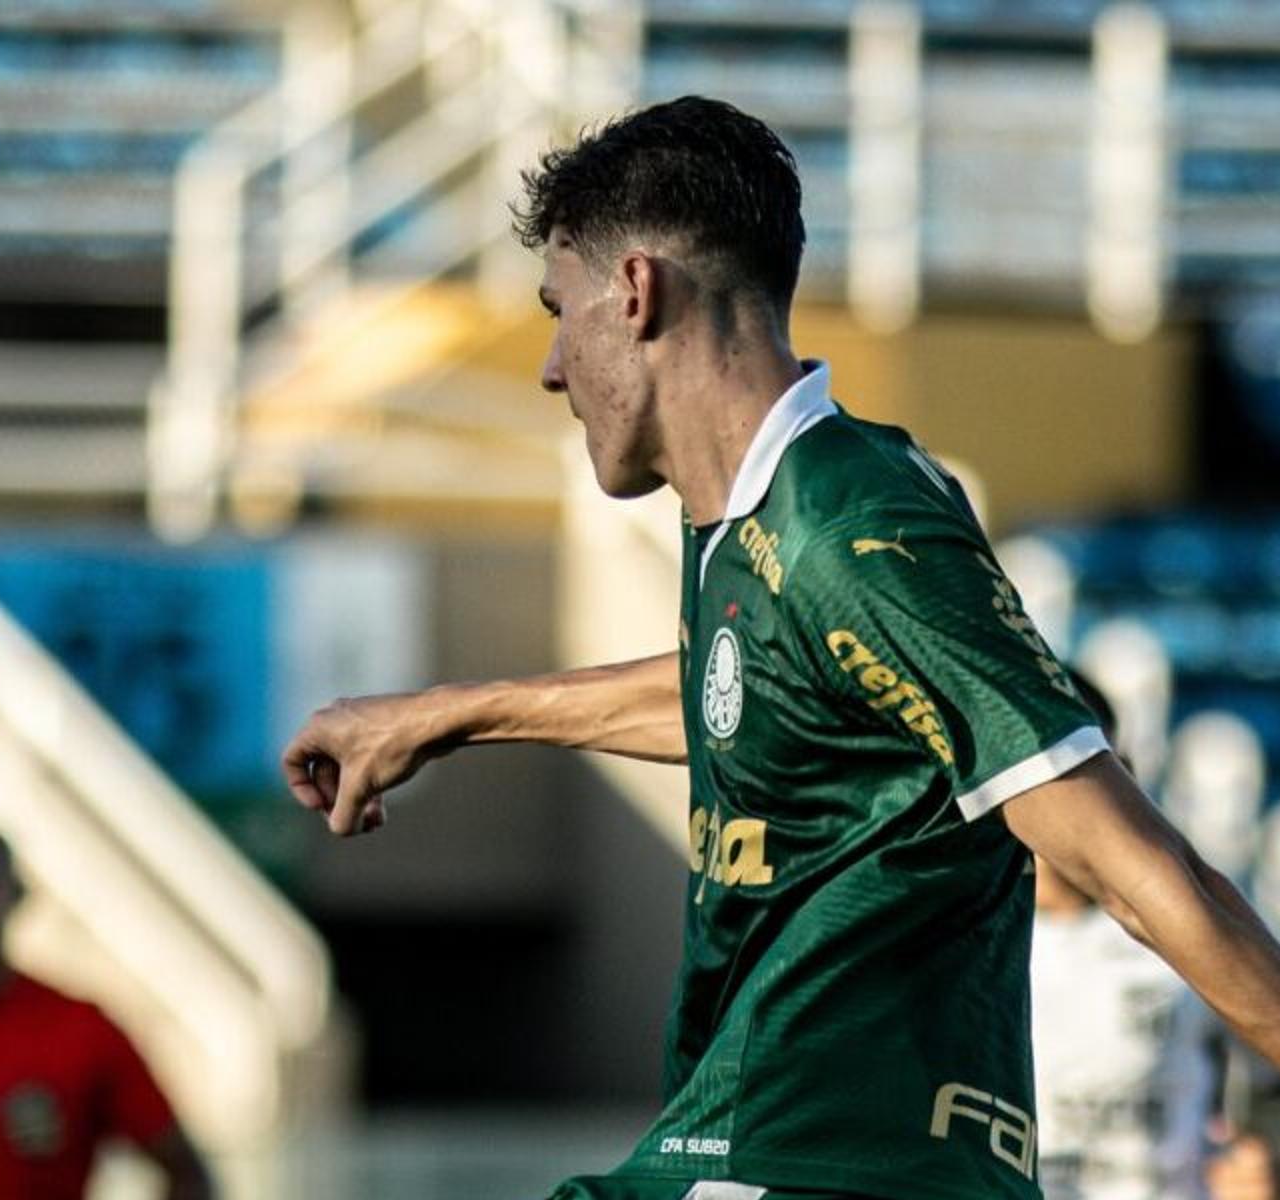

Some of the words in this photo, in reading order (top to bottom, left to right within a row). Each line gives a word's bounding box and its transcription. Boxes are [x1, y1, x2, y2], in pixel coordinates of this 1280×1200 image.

[826, 630, 954, 766] crefisa
[686, 1138, 731, 1156] SUB20
[930, 1082, 1037, 1181] Fa
